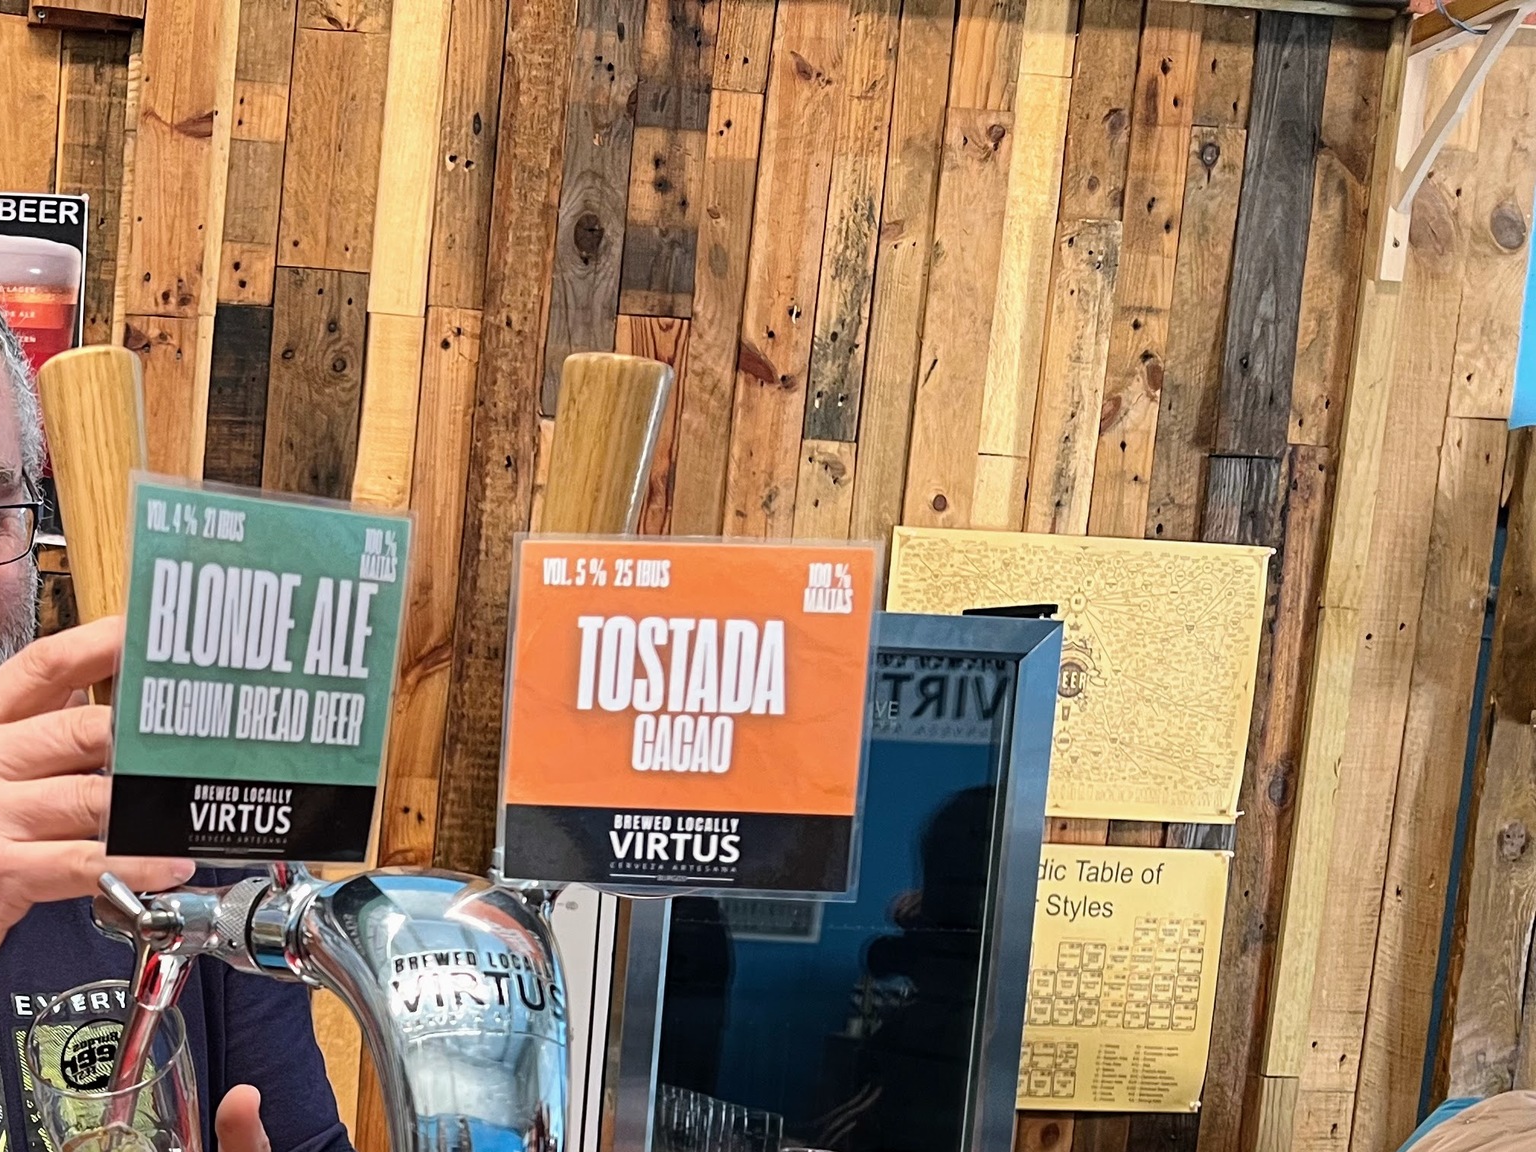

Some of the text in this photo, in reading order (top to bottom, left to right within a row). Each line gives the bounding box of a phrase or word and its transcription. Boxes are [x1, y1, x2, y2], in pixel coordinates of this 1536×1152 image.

[172, 503, 182, 533] 4
[183, 505, 198, 536] %
[365, 527, 397, 556] 100 %
[543, 557, 671, 588] VOL. 5 % 25 IBUS
[808, 563, 851, 589] 100 %
[803, 587, 853, 614] MALTAS
[146, 558, 379, 679] BLONDE ALE
[576, 615, 786, 715] TOSTADA
[139, 676, 365, 747] BELGIUM BREAD BEER
[631, 713, 734, 774] CACAO
[194, 784, 293, 804] BREWED LOCALLY
[190, 801, 293, 835] VIRTUS
[614, 814, 739, 834] BREWED LOCALLY
[609, 830, 741, 863] VIRTUS
[1076, 860, 1133, 884] Table
[1141, 863, 1165, 885] of
[1046, 894, 1114, 923] Styles
[394, 951, 478, 973] BREWED
[14, 989, 126, 1016] EVERY
[392, 971, 565, 1020] VIRTUS
